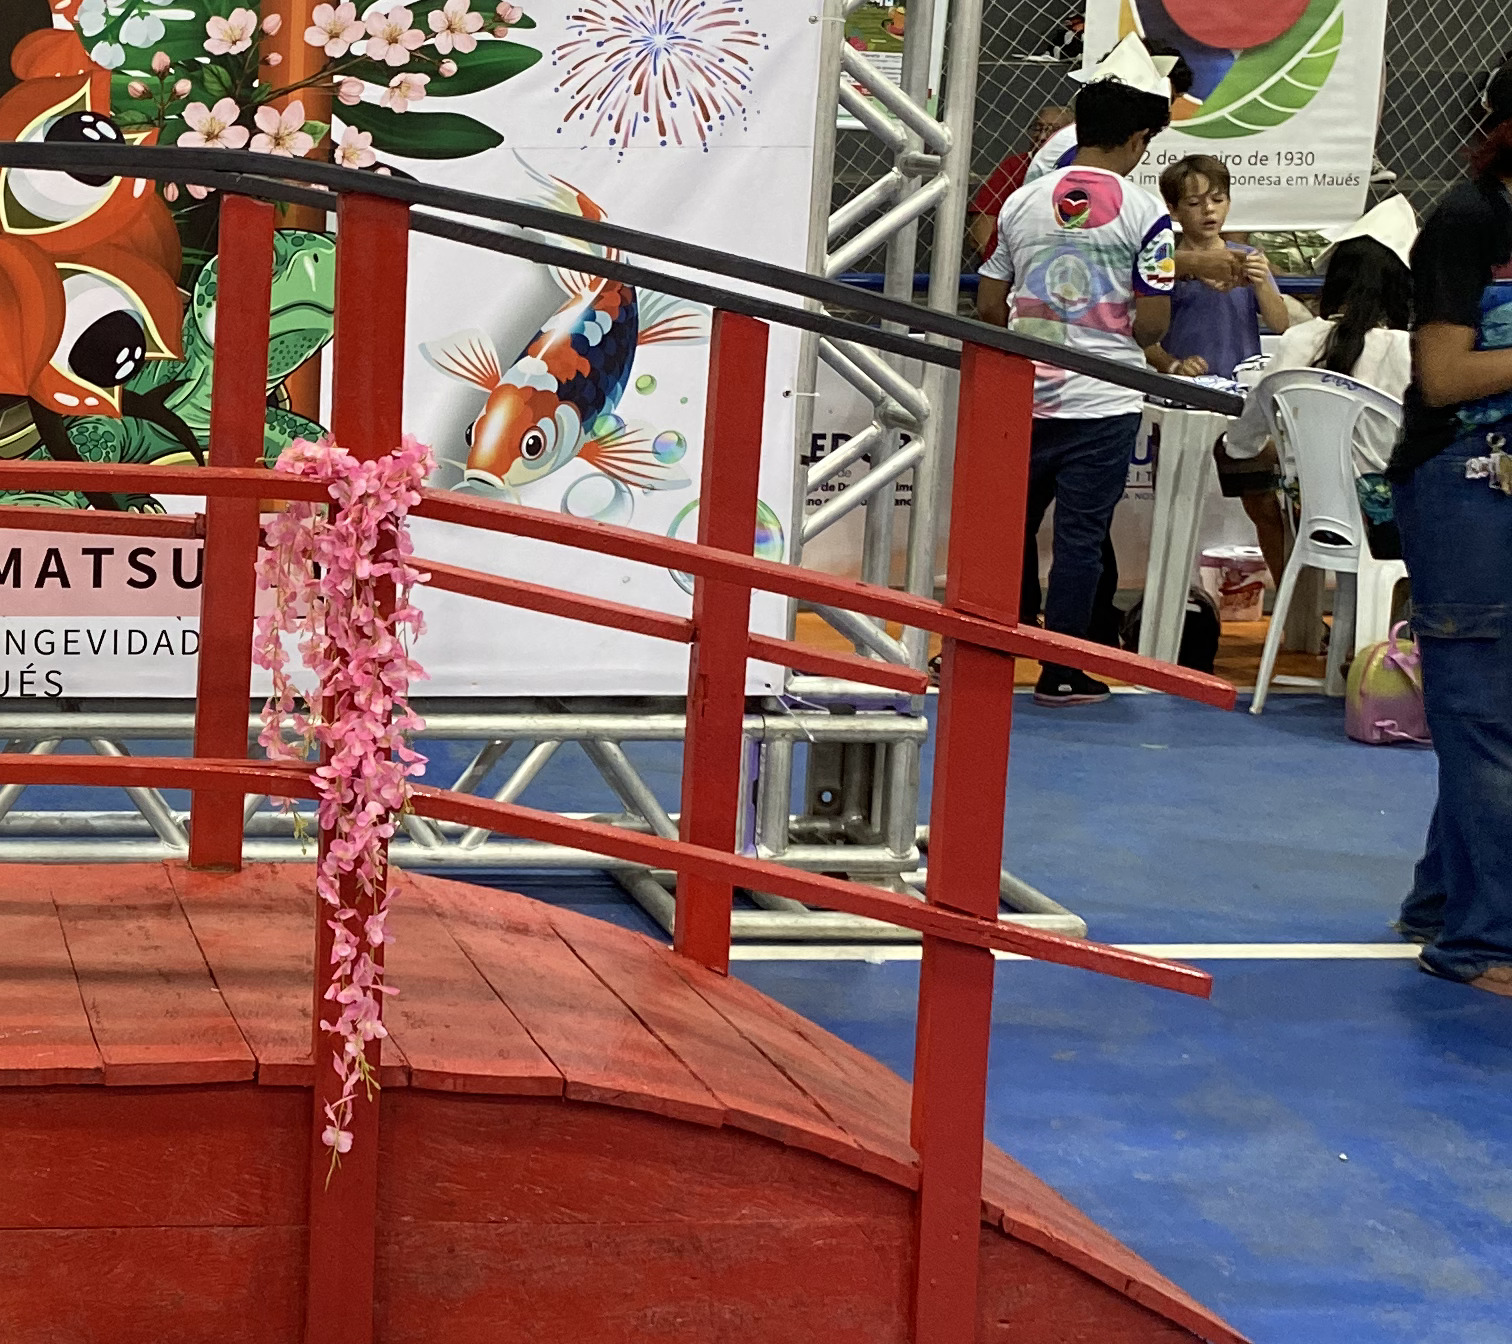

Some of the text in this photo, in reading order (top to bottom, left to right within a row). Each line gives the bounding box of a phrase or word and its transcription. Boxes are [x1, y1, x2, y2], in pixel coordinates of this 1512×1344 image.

[1247, 150, 1269, 166] de
[1276, 151, 1315, 167] 1930
[1285, 175, 1309, 186] em
[1313, 172, 1360, 187] Maués
